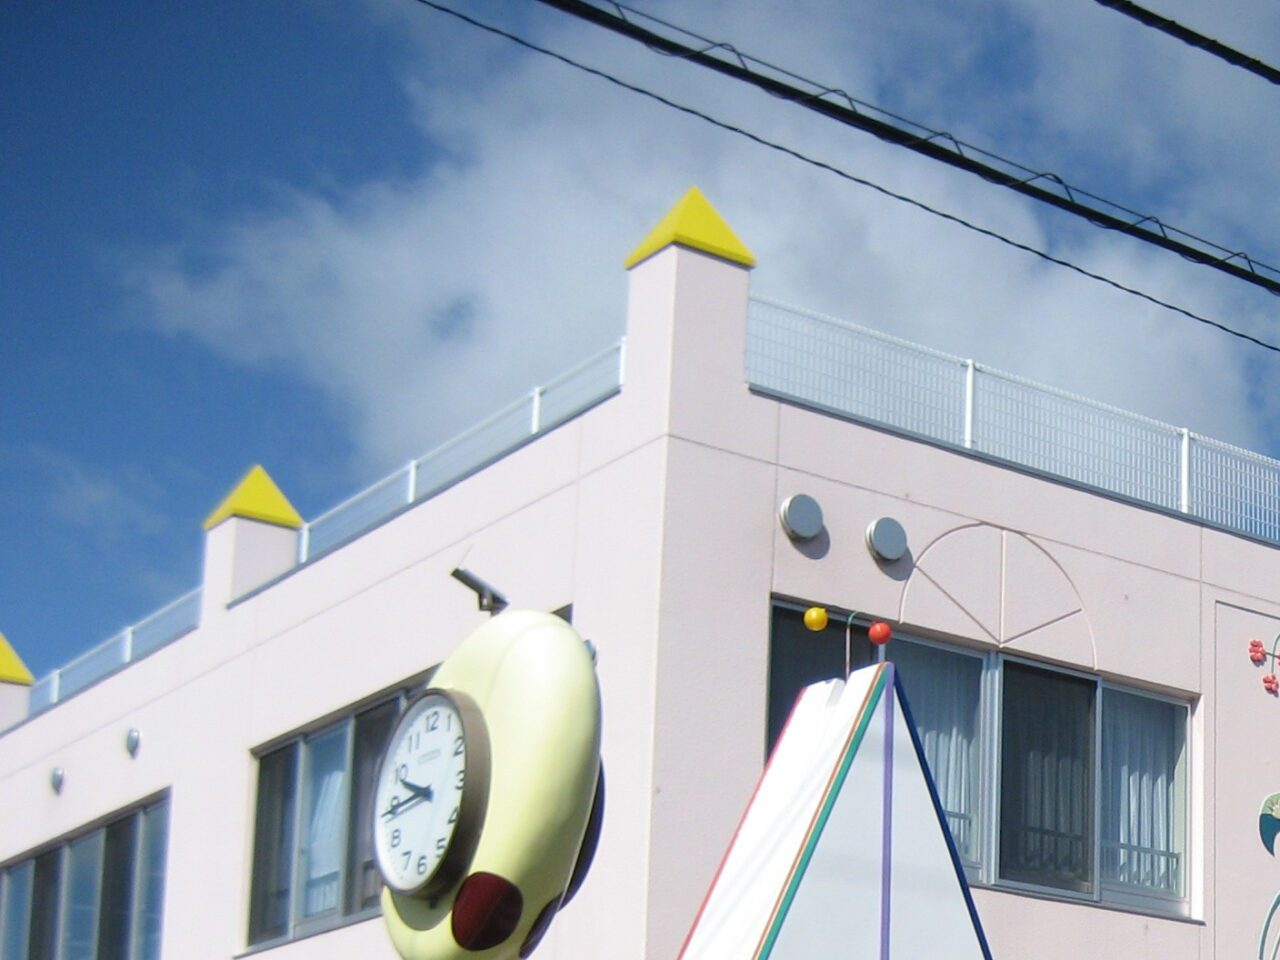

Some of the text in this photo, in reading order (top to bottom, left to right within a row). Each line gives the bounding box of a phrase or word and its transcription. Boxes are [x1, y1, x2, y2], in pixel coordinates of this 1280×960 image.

[425, 710, 440, 733] 12
[407, 731, 422, 754] 11
[453, 736, 465, 757] 2
[393, 763, 409, 786] 10
[455, 769, 465, 790] 3
[447, 805, 460, 825] 4
[391, 828, 401, 848] 8
[435, 838, 447, 858] 5
[402, 851, 413, 872] 7
[416, 855, 428, 876] 6
